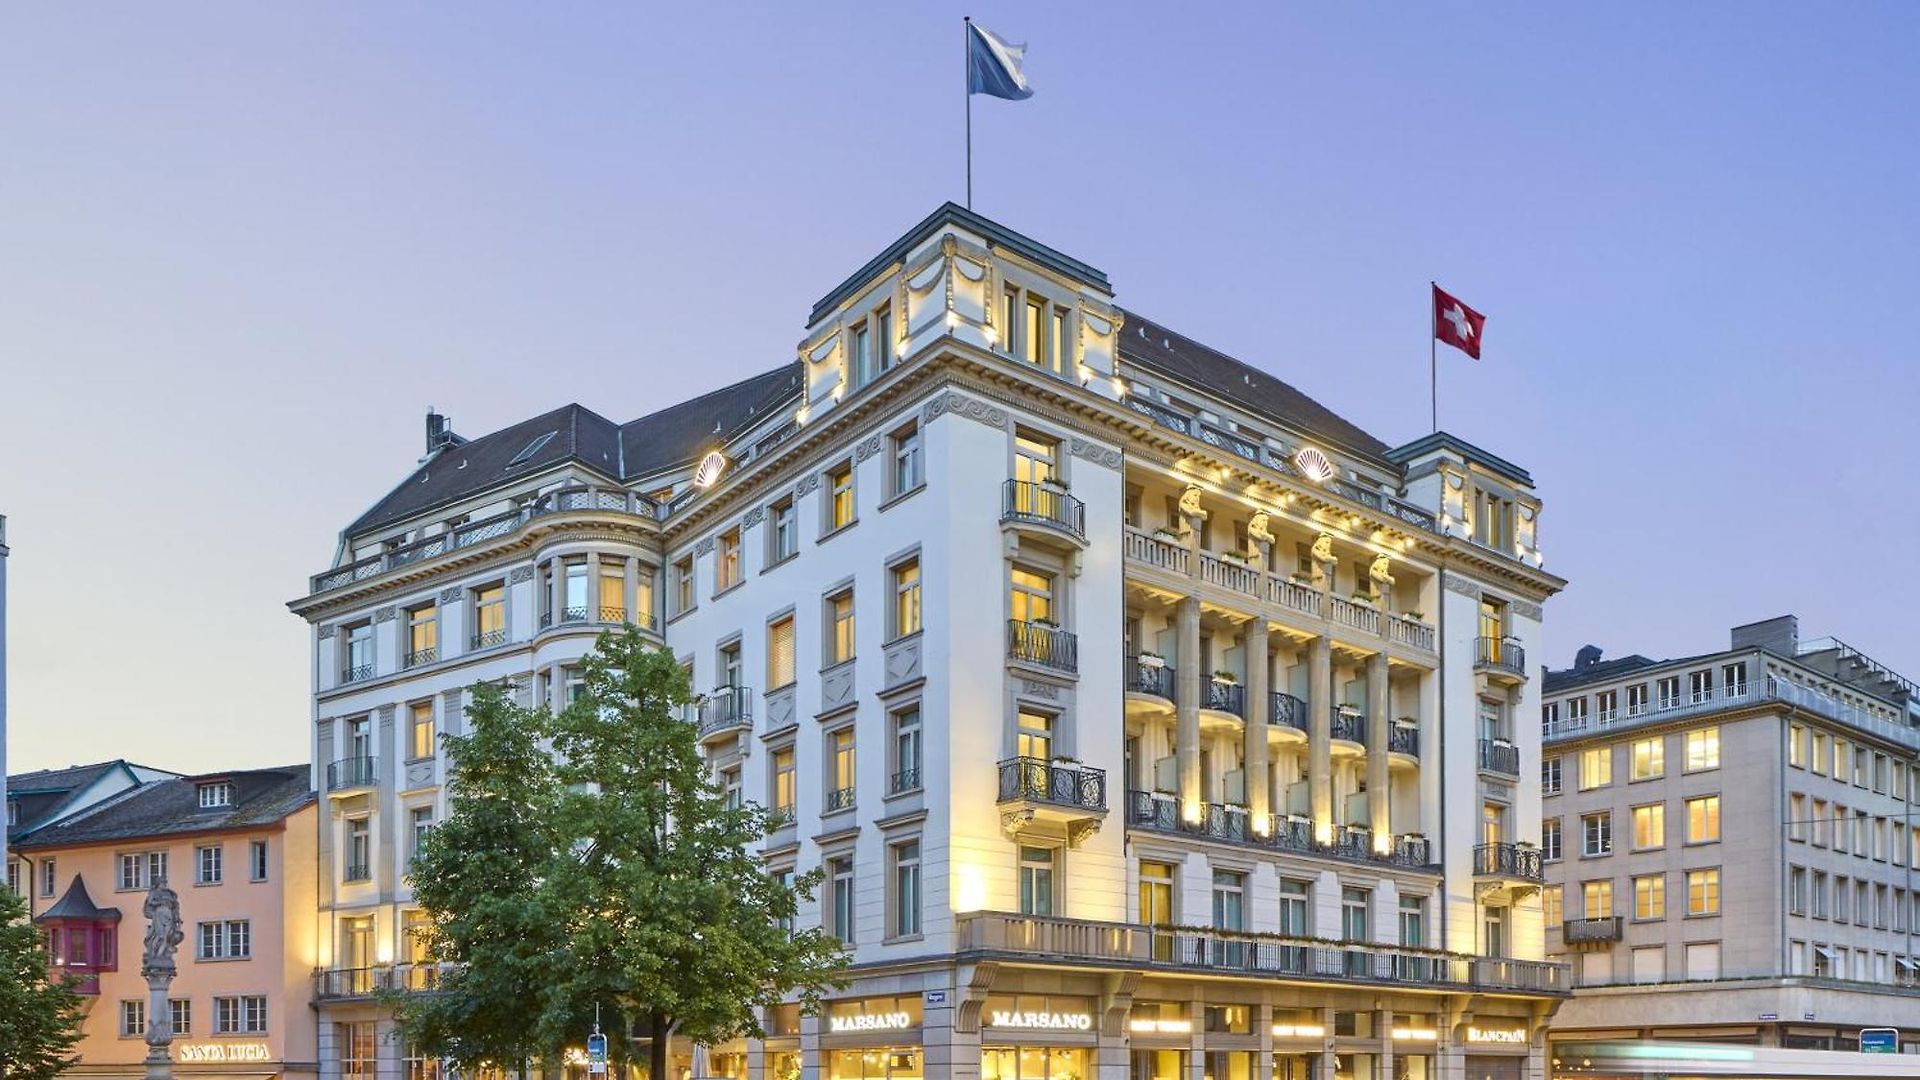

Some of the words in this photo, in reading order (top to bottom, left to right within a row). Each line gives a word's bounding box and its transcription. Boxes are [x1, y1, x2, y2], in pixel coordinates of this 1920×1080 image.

[831, 1012, 909, 1031] MARSANO
[992, 1011, 1091, 1030] MARSANO
[1467, 1027, 1525, 1042] BLANCPAIN
[181, 1045, 225, 1060] SANTA
[227, 1044, 270, 1060] LUCIA
